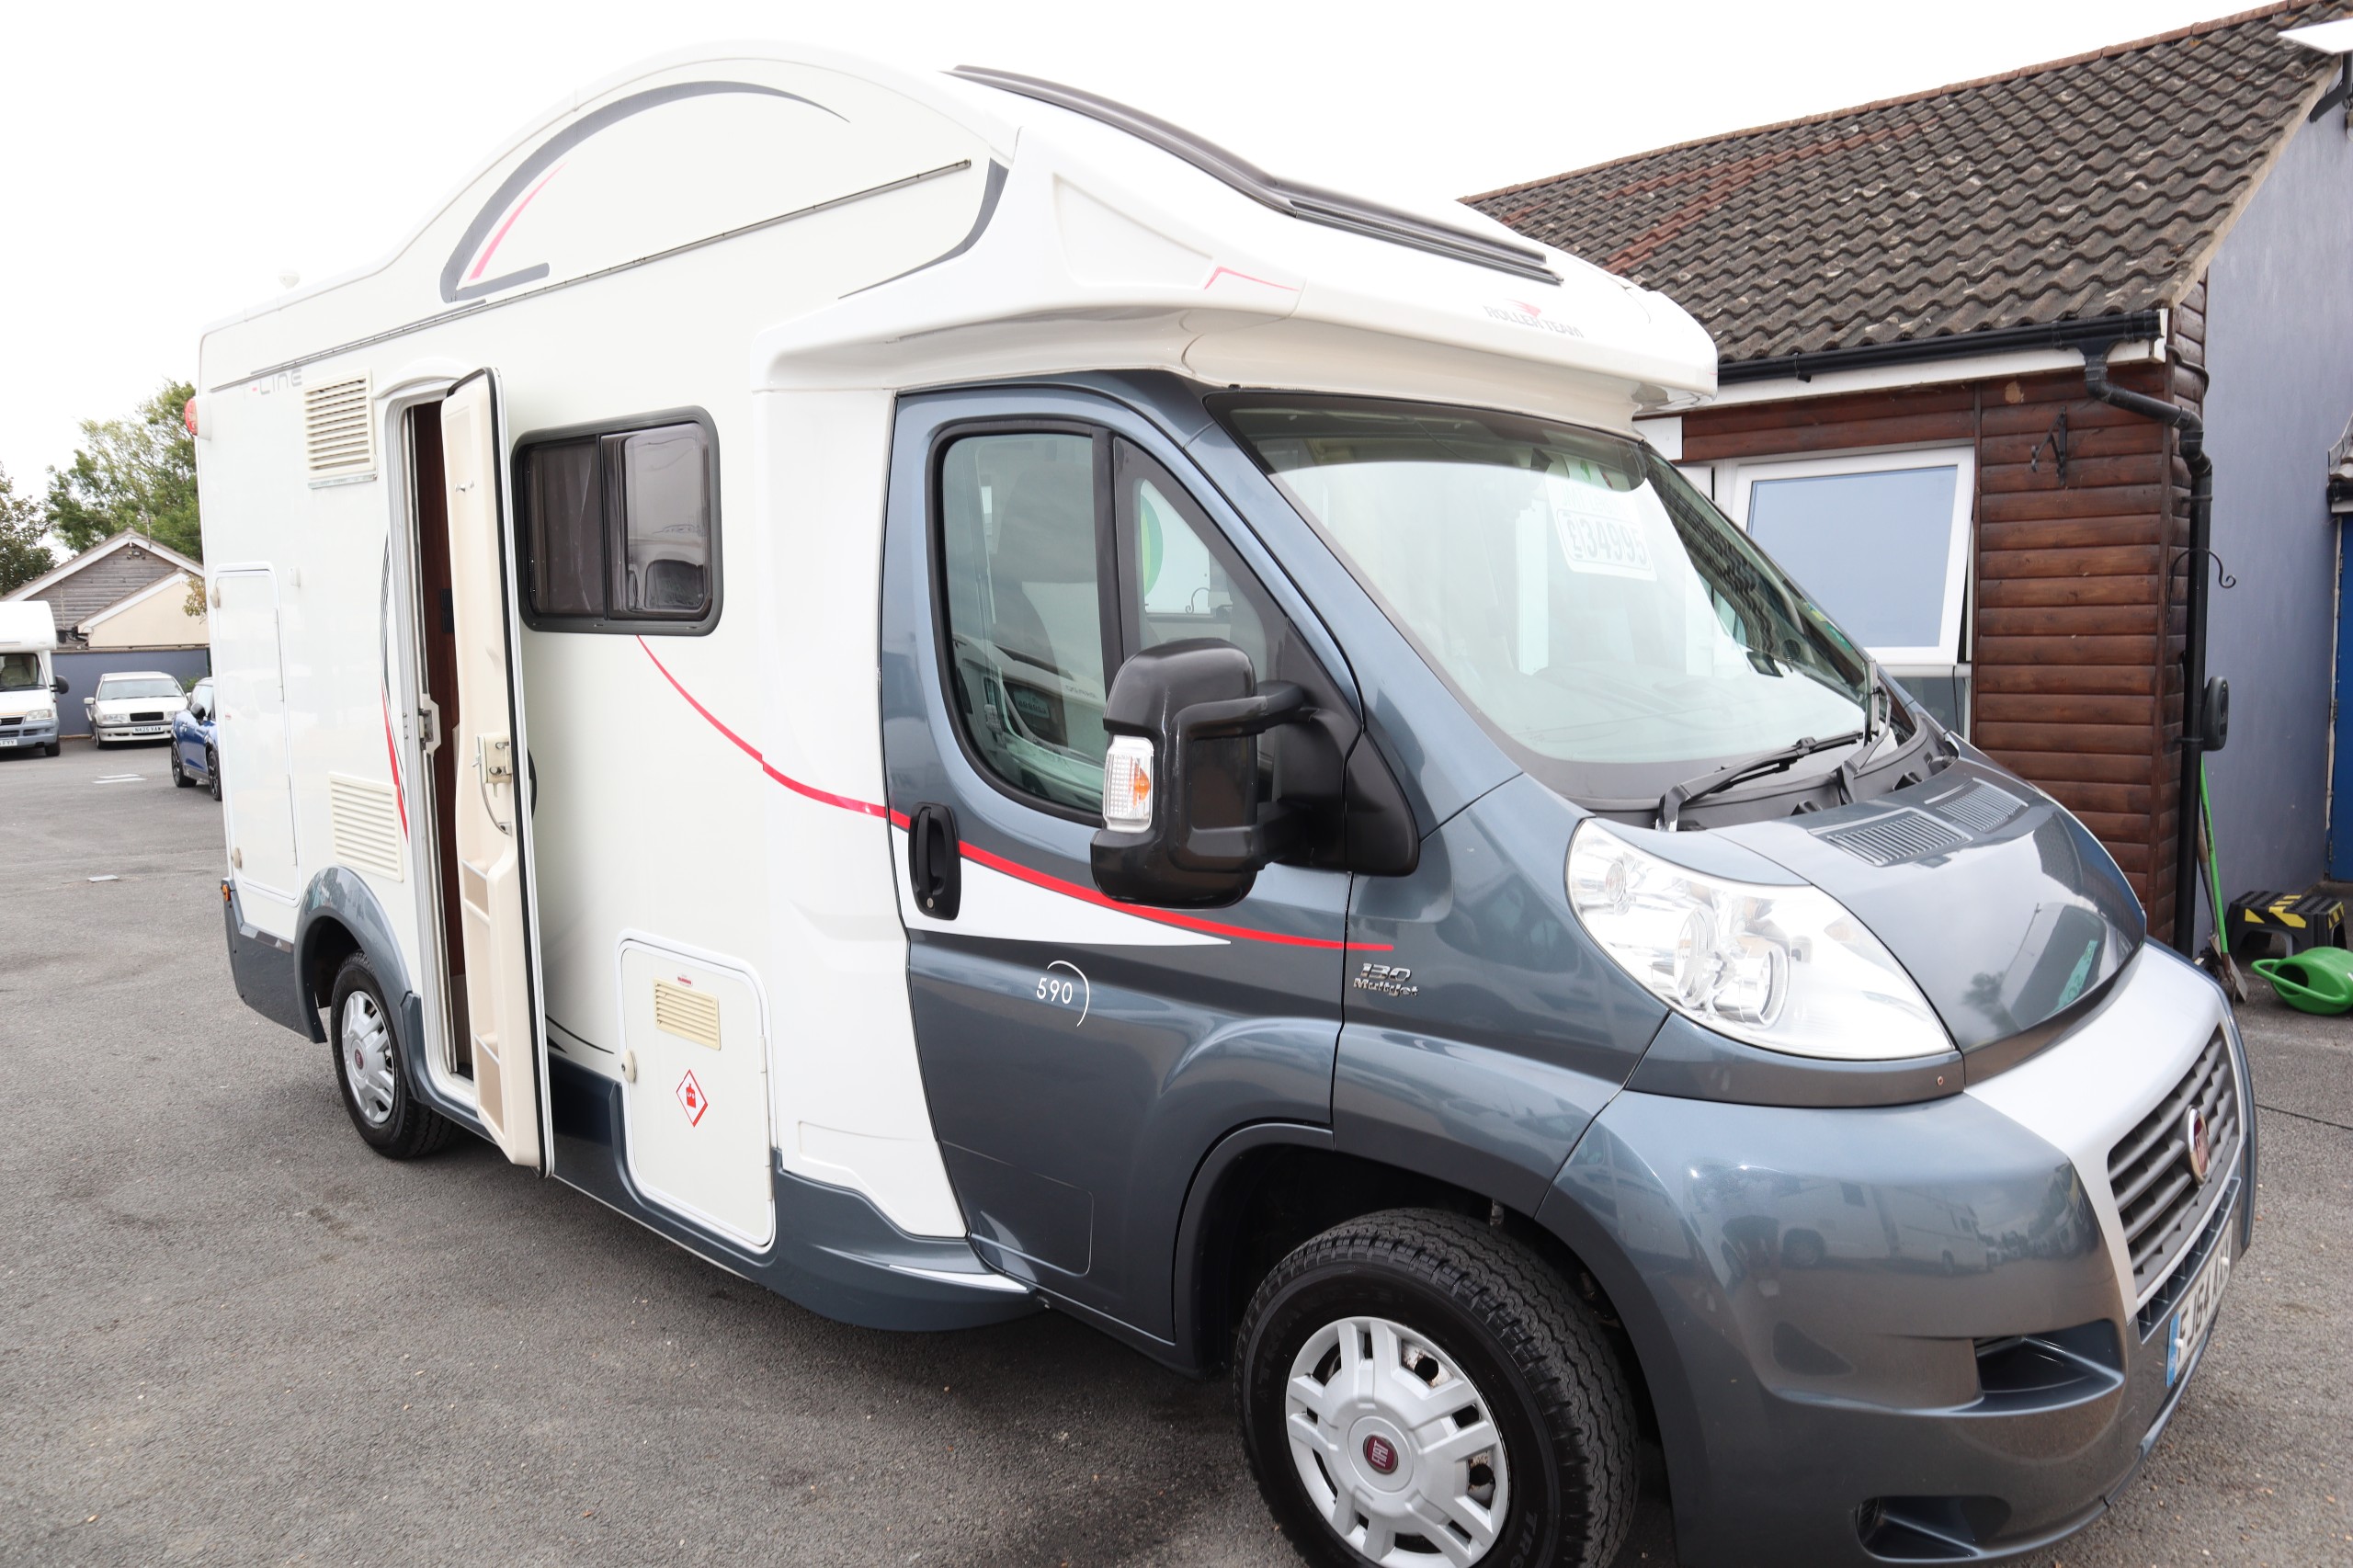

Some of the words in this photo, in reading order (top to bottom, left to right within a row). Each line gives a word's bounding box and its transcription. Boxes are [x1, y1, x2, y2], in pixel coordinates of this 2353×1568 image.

[1483, 305, 1543, 330] ROLLER
[1541, 318, 1585, 338] TEAM
[1566, 517, 1648, 565] £34995
[1360, 962, 1412, 983] 130
[1036, 977, 1073, 1005] 590
[2177, 1270, 2211, 1363] FJ64
[1371, 1439, 1389, 1468] FIAT
